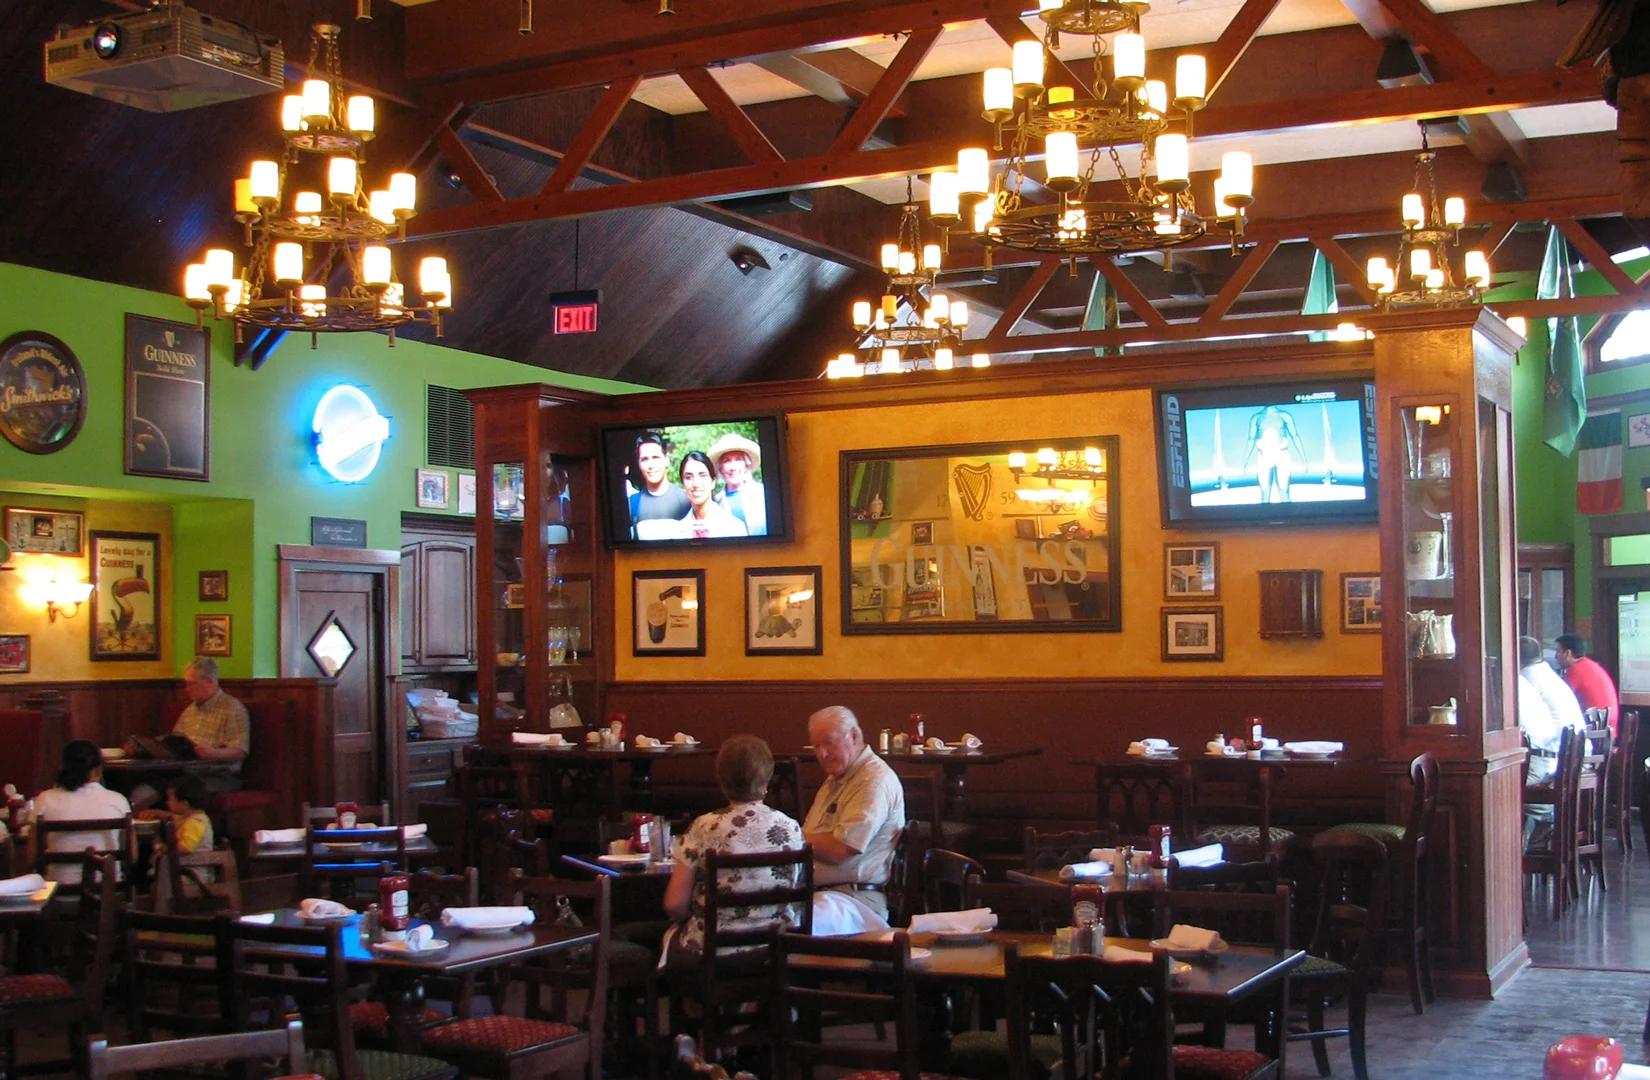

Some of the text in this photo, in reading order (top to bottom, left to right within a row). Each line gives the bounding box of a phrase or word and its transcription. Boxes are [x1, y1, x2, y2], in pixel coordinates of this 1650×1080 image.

[559, 306, 593, 332] EXIT
[145, 344, 197, 367] GUINNESS
[1, 385, 72, 412] Smithwick's
[1001, 491, 1016, 505] 59
[100, 546, 121, 556] Lovely
[123, 547, 135, 557] day
[136, 546, 146, 556] for
[100, 557, 134, 569] GUINNESS
[873, 537, 1088, 588] GUINNESS
